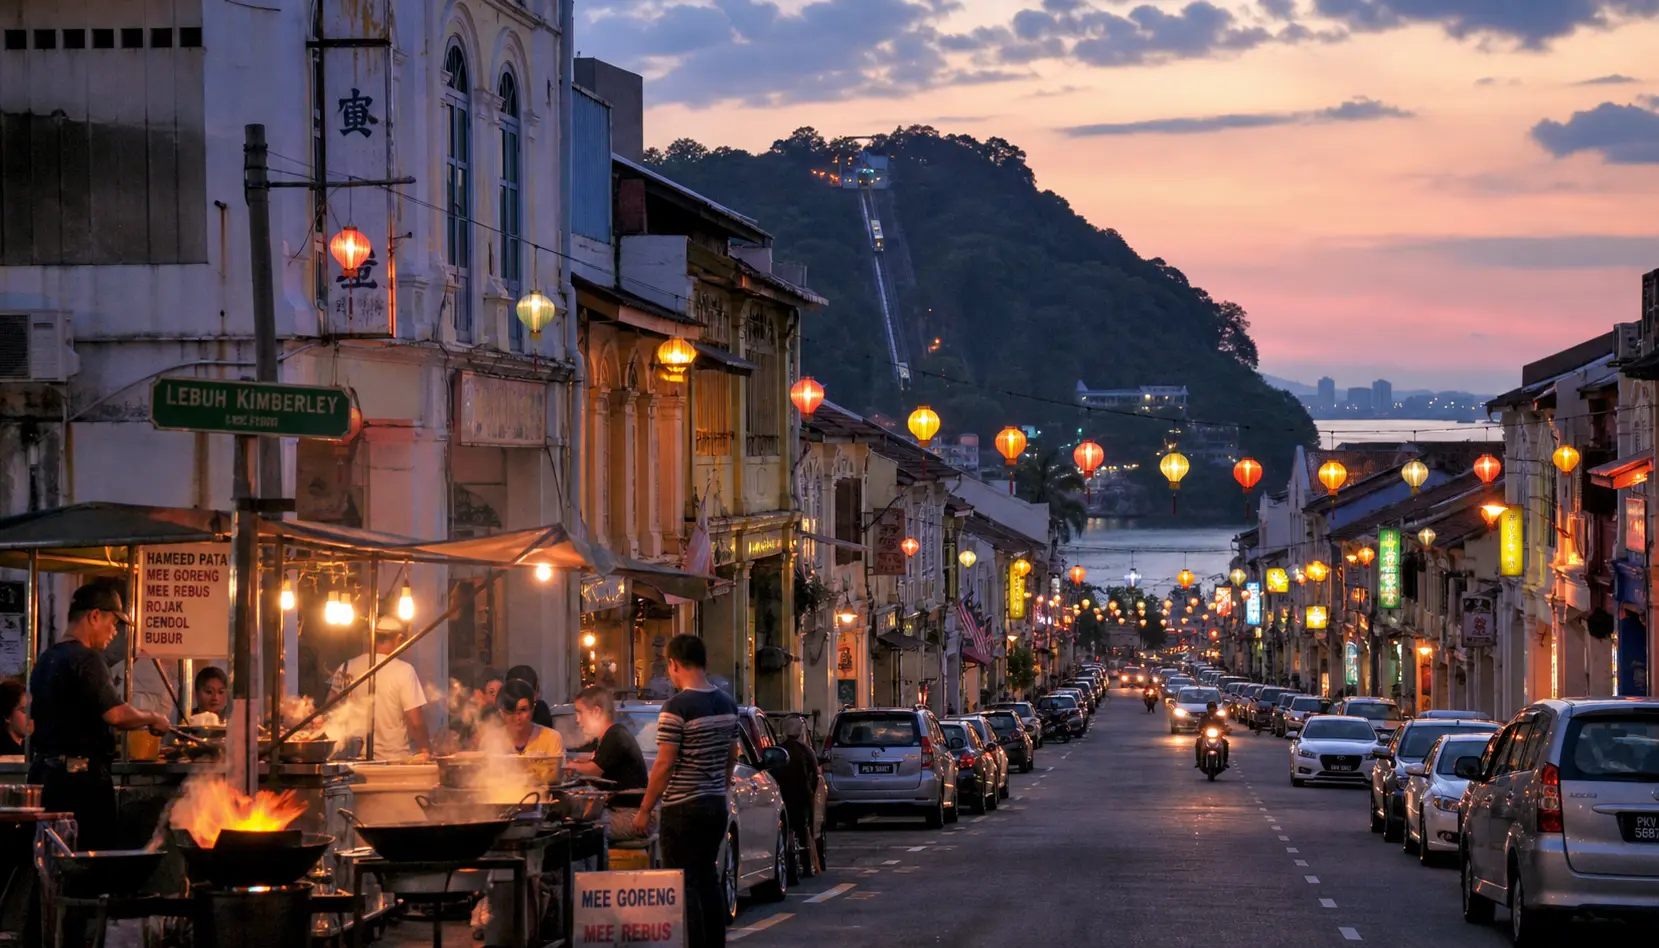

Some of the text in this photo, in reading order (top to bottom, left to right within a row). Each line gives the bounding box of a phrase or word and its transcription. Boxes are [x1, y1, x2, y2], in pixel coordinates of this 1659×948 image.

[166, 384, 226, 409] LEBUH
[146, 552, 195, 566] HAMEED
[146, 569, 219, 582] MEE GORENG
[146, 585, 210, 598] MEE REBUS
[146, 601, 184, 613] ROJAK
[145, 616, 190, 629] CENDOL
[145, 632, 183, 644] BUBUR
[1636, 816, 1657, 828] PKV
[1634, 827, 1659, 839] 5687
[581, 887, 676, 908] MEE GORENG
[583, 922, 672, 943] MEE REBUS
